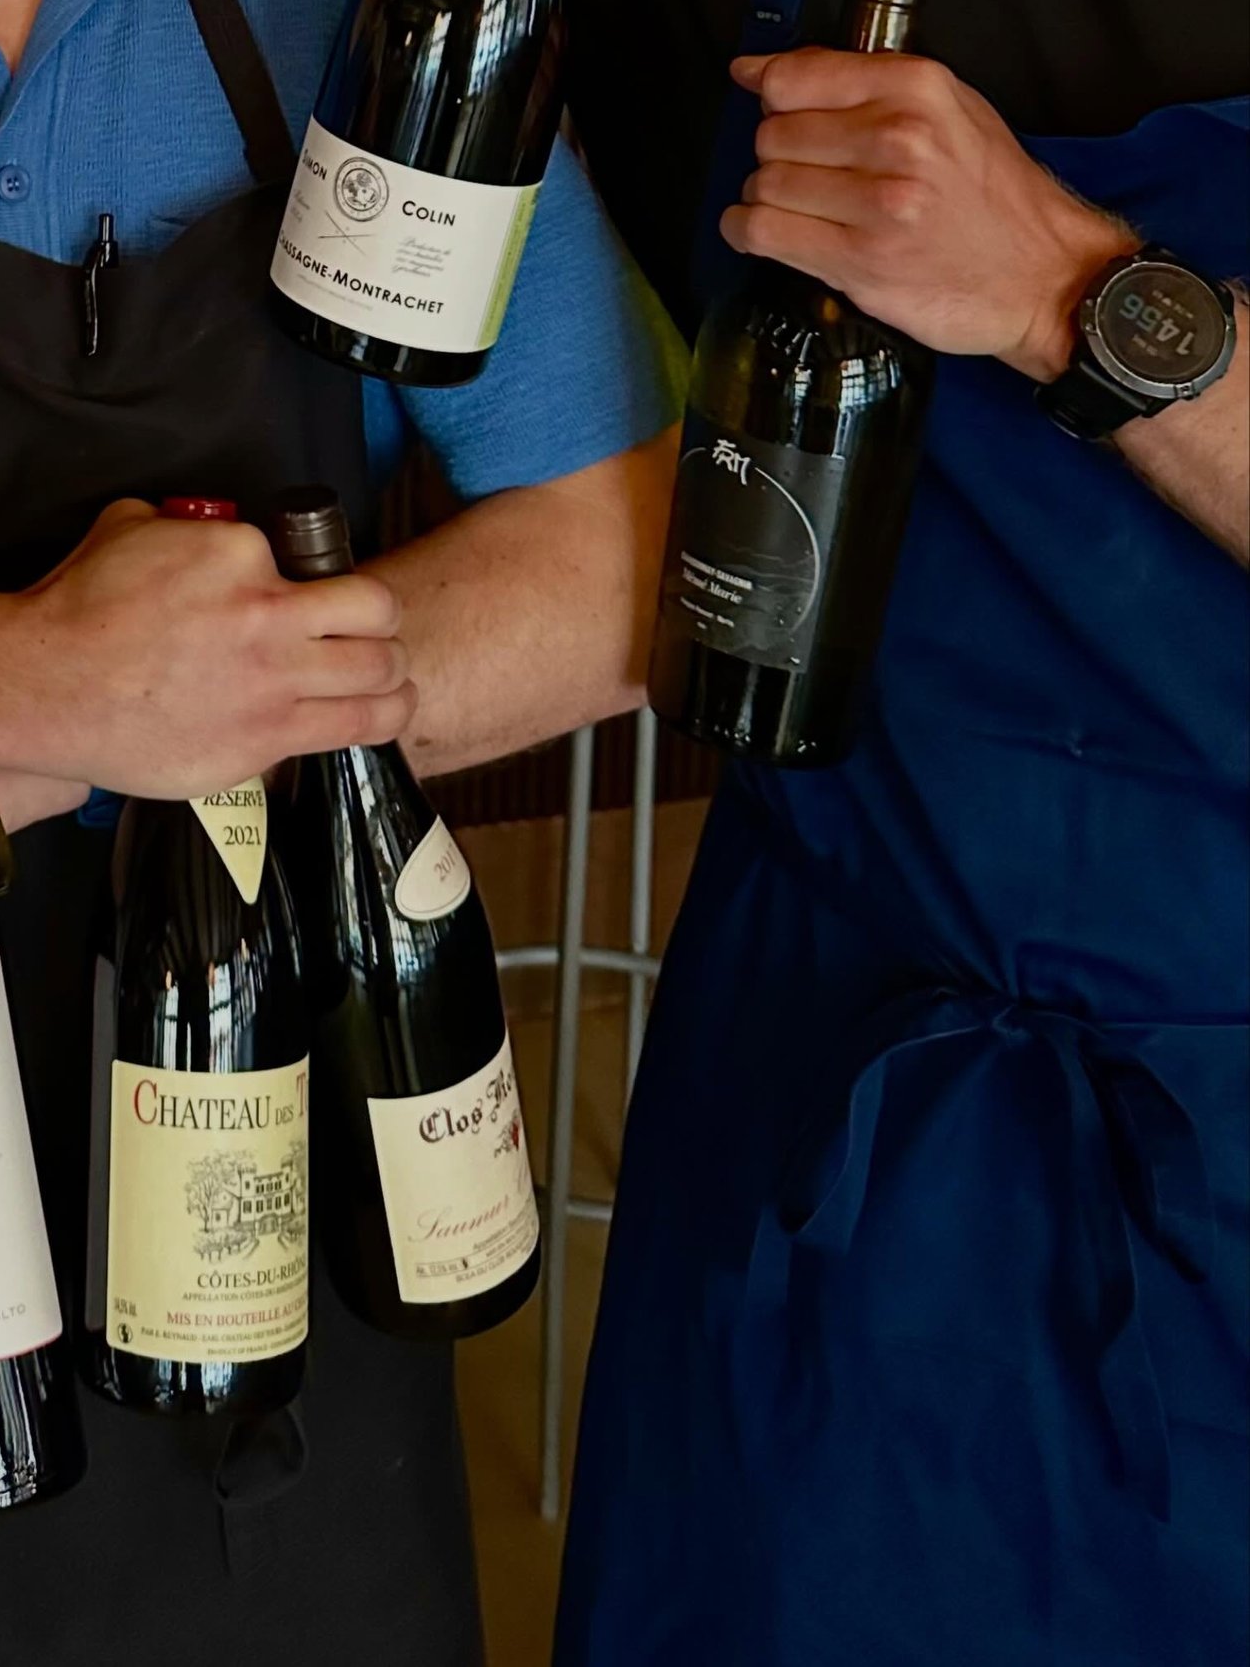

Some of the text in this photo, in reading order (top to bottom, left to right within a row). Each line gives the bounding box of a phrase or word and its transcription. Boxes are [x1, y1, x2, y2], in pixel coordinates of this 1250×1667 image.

[401, 199, 456, 227] COLIN
[223, 825, 262, 847] 2021
[133, 1071, 308, 1131] CHATEAU DES T
[418, 1097, 484, 1145] Clos
[407, 1192, 511, 1243] Saumur
[166, 1311, 192, 1326] MIS
[195, 1312, 213, 1327] EN
[216, 1306, 280, 1327] BOUTEILLE
